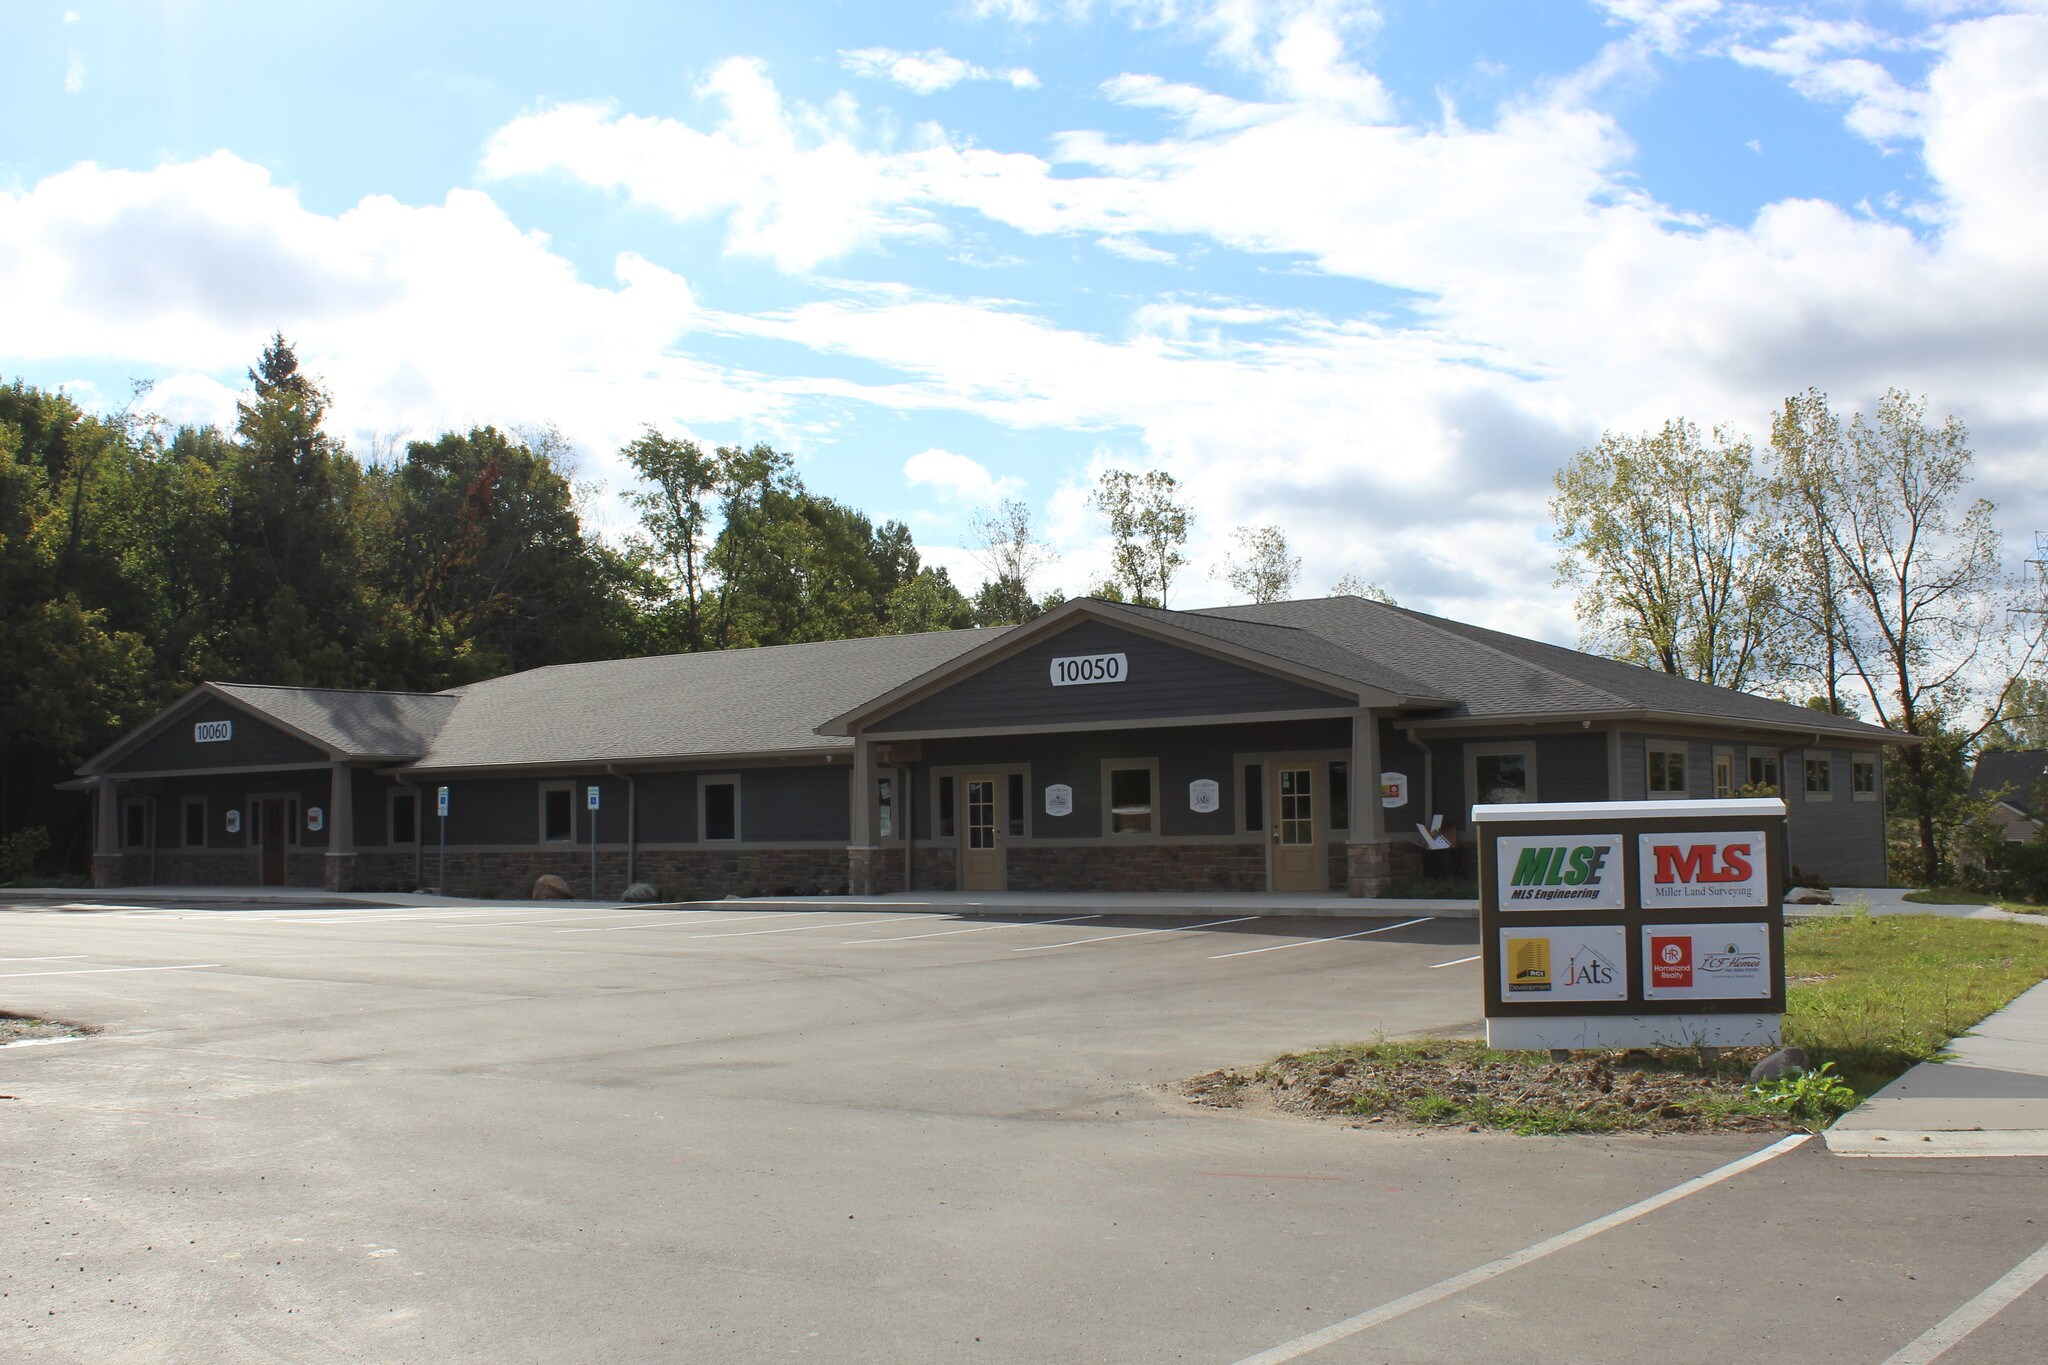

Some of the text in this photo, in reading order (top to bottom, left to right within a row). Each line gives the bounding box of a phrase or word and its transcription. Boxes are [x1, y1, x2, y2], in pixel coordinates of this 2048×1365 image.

[1058, 657, 1119, 682] 10050
[197, 723, 227, 740] 10060
[1510, 846, 1611, 886] MLSE
[1653, 844, 1753, 884] MLS
[1511, 888, 1600, 900] MLS Engineering
[1655, 885, 1752, 898] Miller Land Surveying
[1726, 956, 1761, 968] Homes
[1509, 983, 1551, 991] Development
